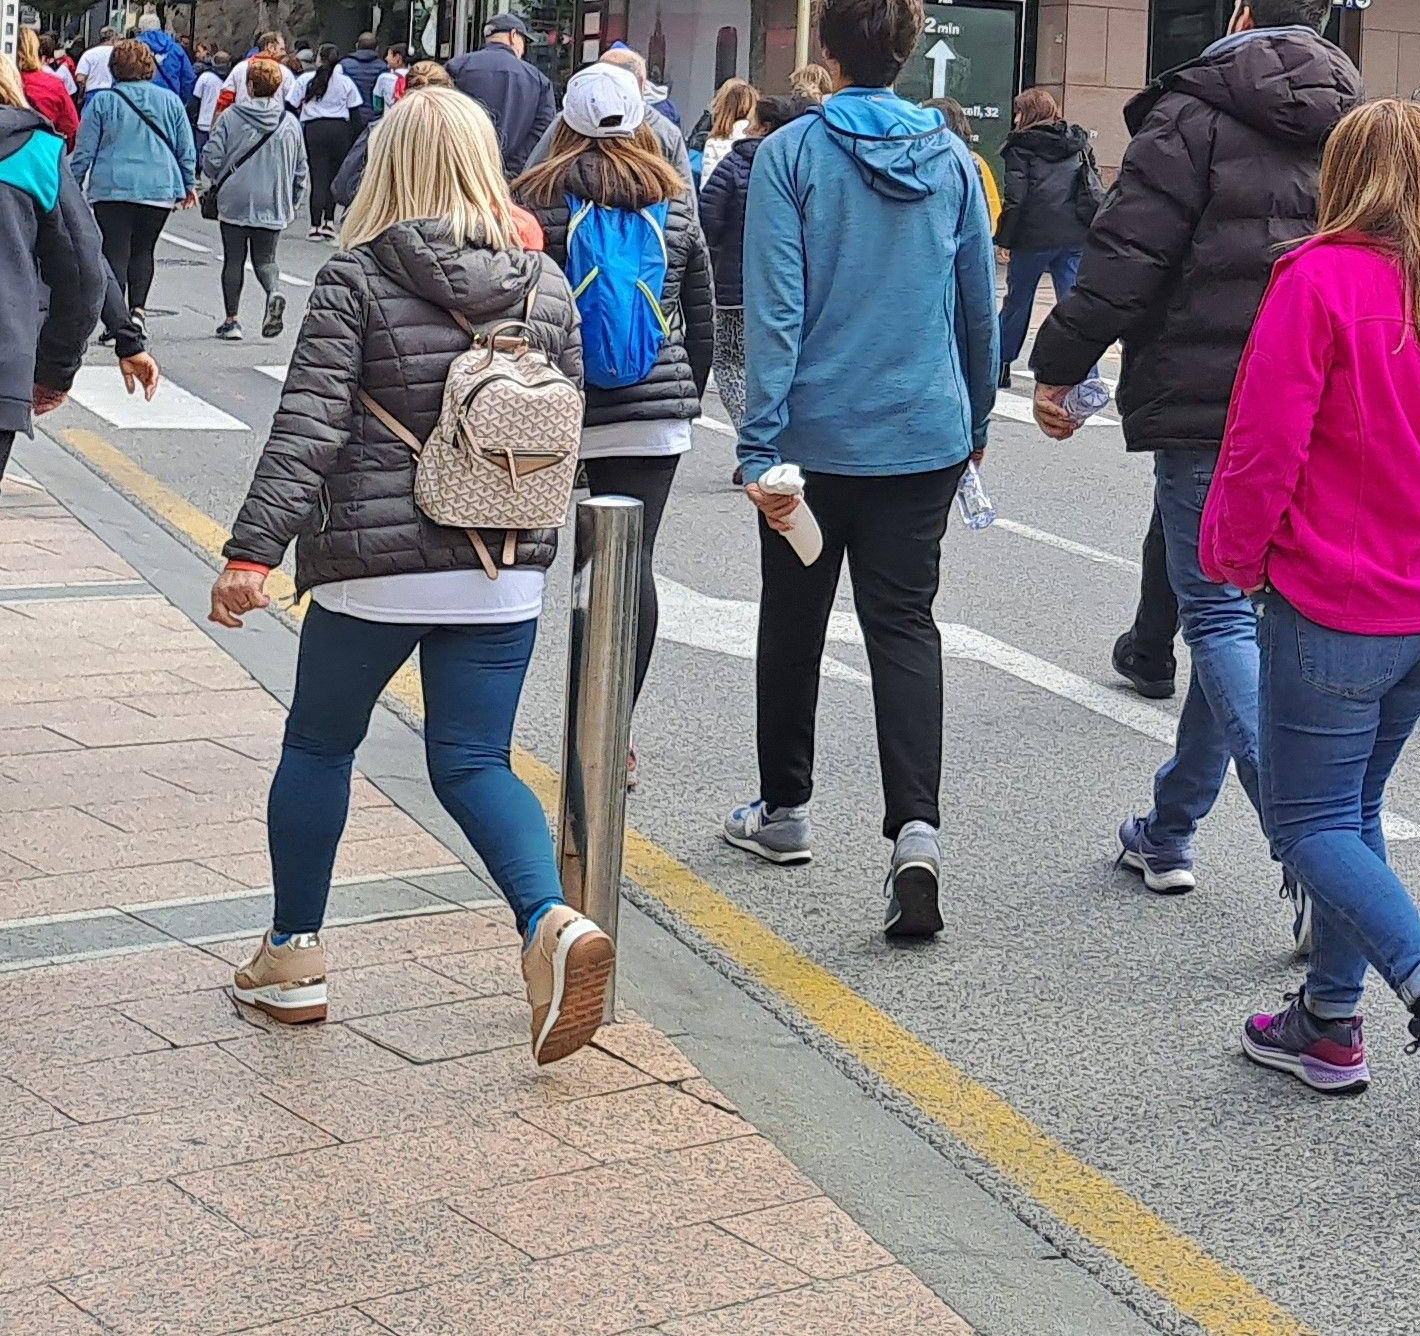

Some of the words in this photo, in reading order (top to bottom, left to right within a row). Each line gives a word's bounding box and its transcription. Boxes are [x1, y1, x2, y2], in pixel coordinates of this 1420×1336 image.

[924, 17, 936, 33] 2
[937, 22, 960, 35] min
[983, 106, 999, 118] 32
